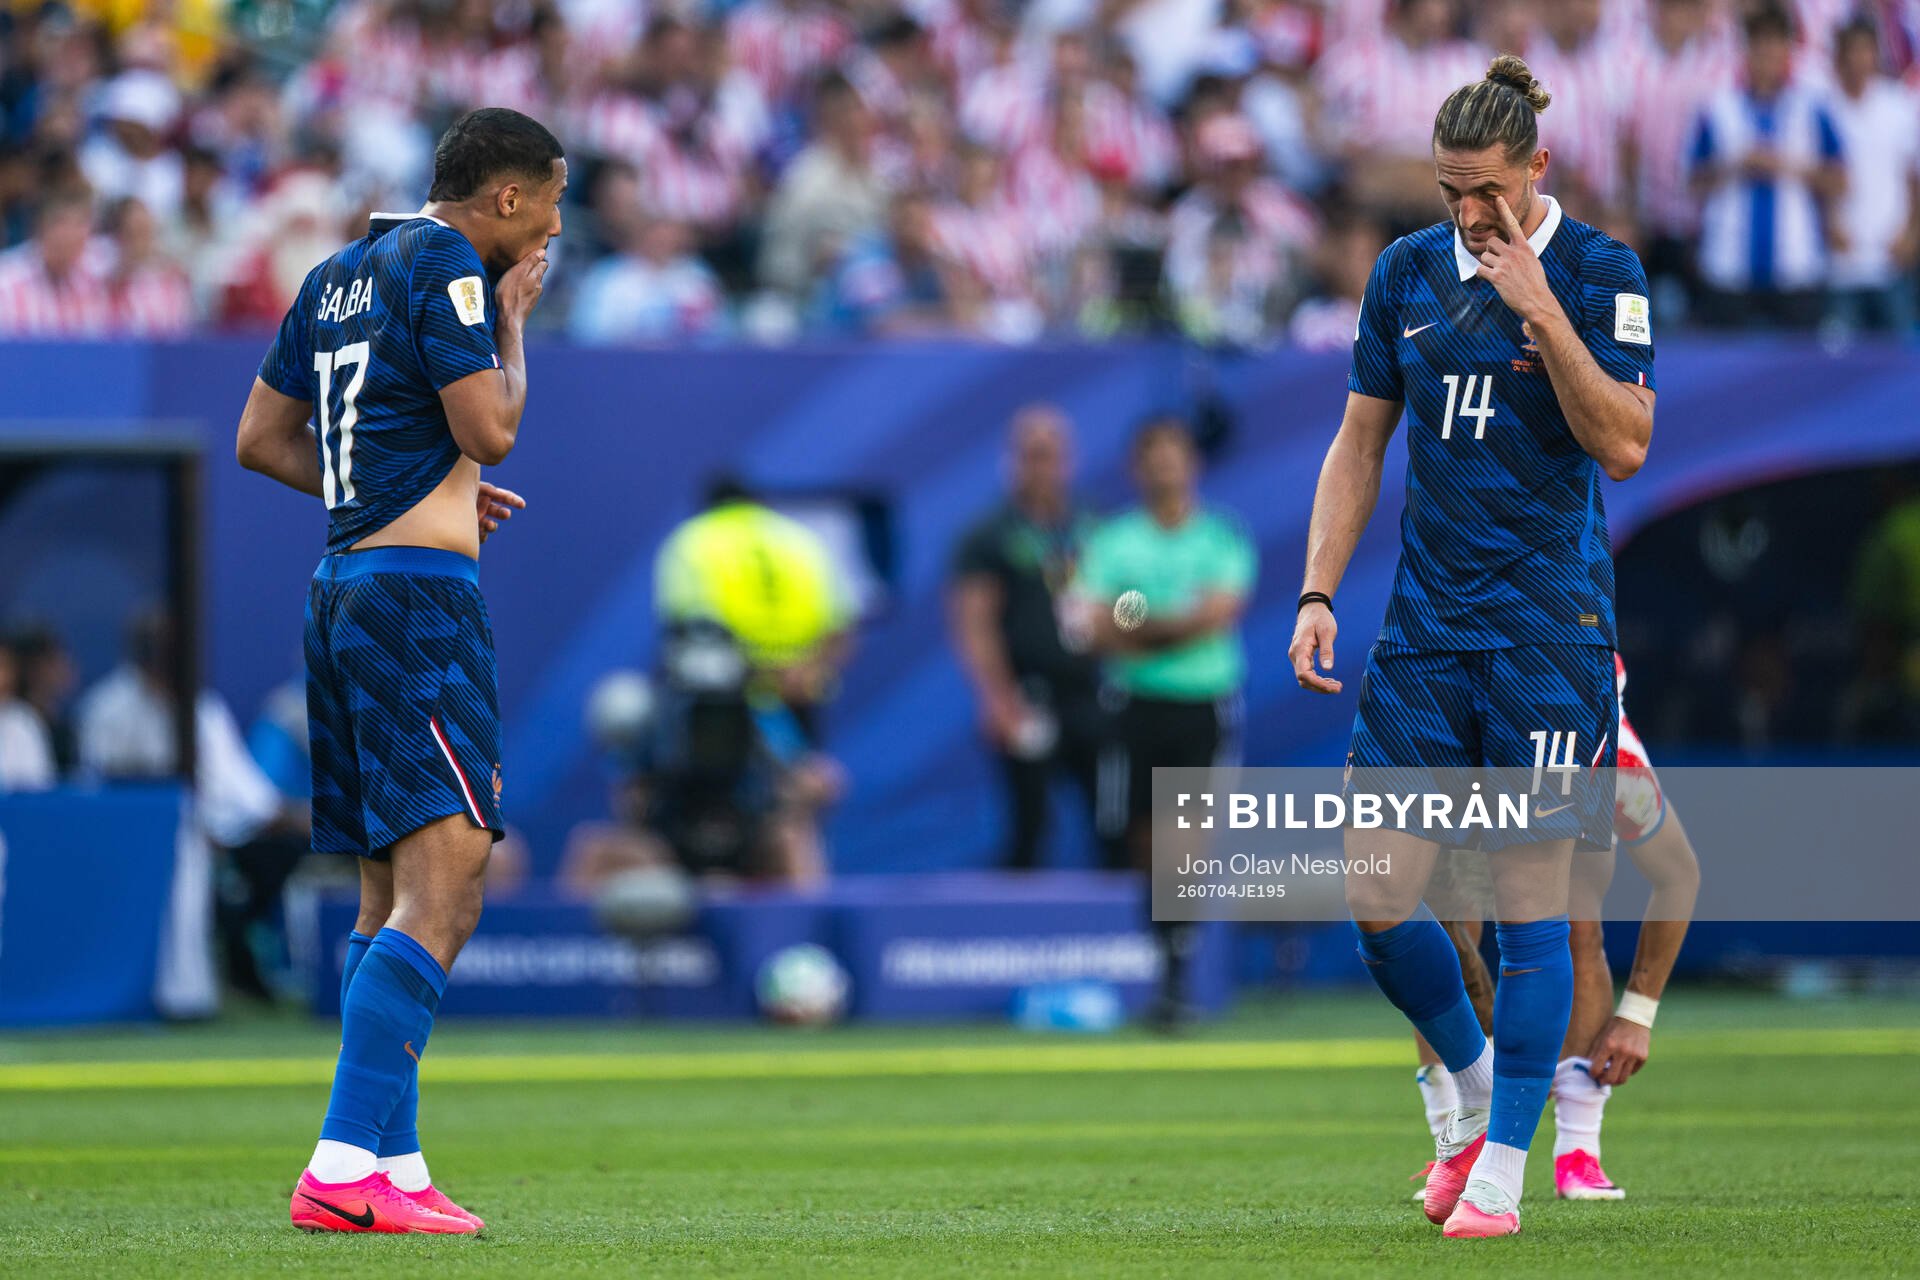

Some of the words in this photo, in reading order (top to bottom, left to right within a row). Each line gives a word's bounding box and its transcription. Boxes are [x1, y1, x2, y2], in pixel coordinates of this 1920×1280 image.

[314, 341, 370, 511] 17
[1441, 374, 1496, 440] 14
[1529, 731, 1581, 796] 14
